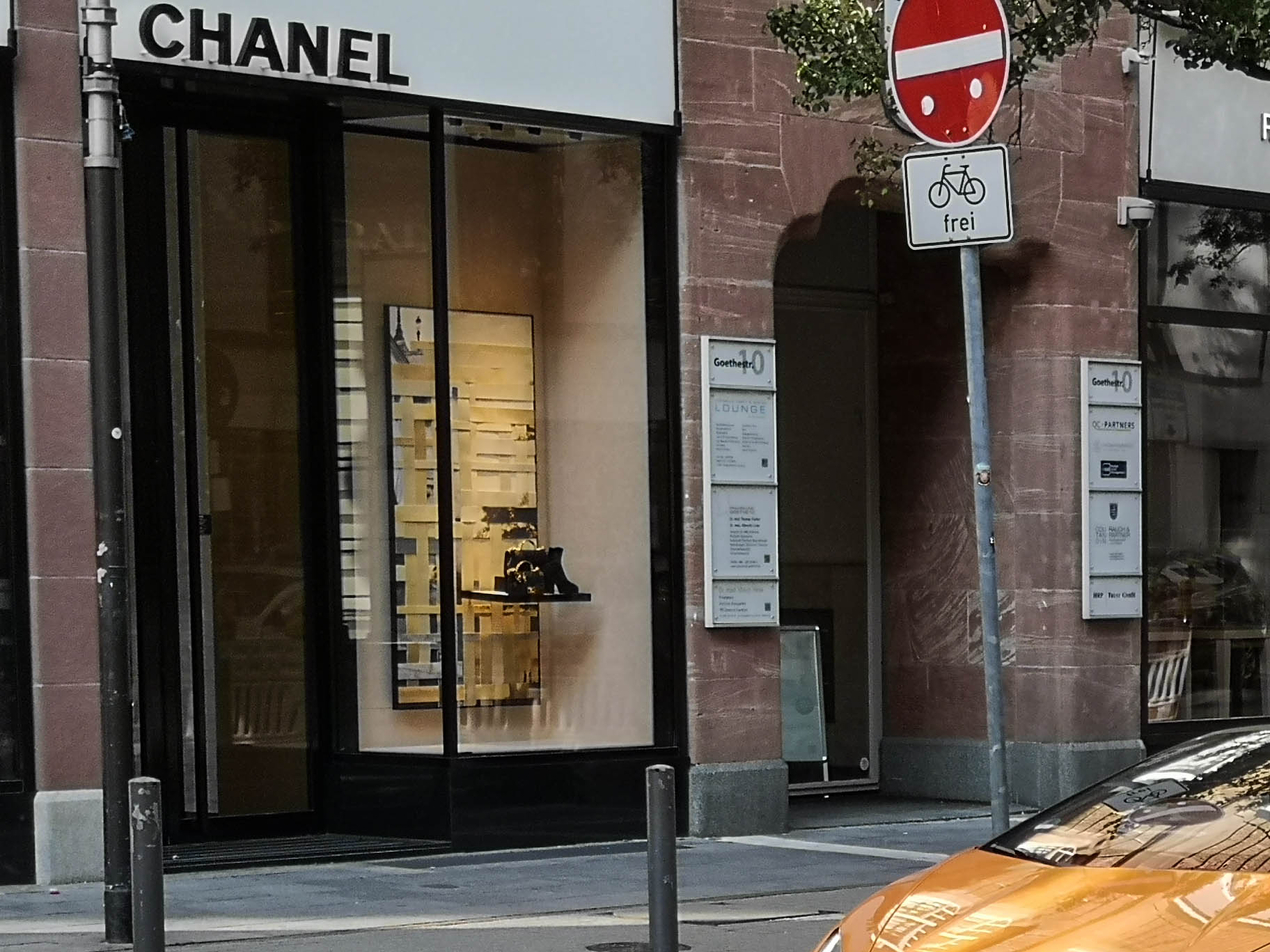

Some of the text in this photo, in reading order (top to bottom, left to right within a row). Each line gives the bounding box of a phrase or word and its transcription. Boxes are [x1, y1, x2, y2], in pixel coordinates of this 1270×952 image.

[139, 3, 409, 86] CHANEL
[944, 211, 975, 232] frei
[714, 349, 765, 375] Goethestr. 10
[714, 403, 766, 414] LOUNGE
